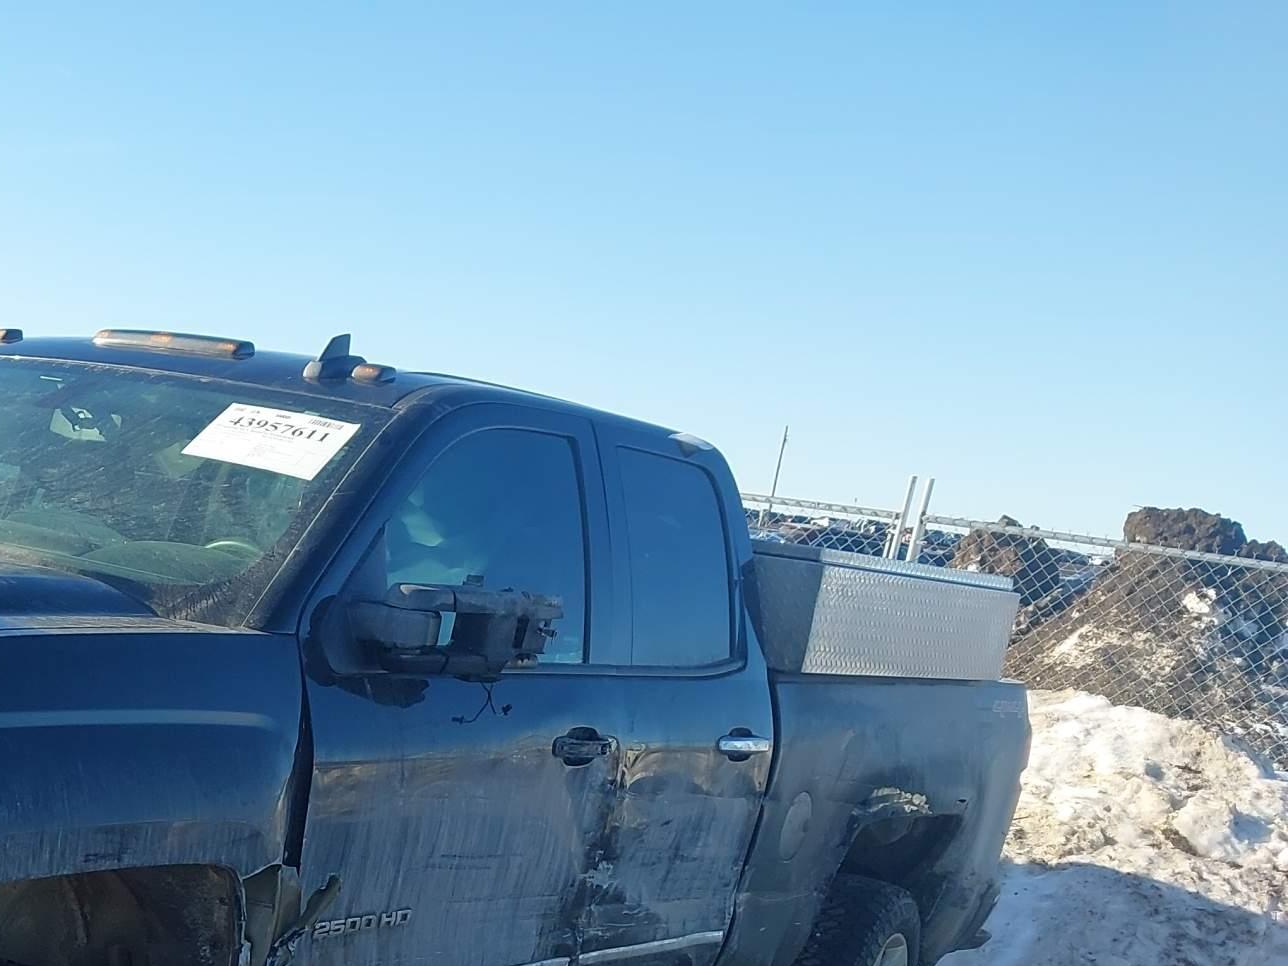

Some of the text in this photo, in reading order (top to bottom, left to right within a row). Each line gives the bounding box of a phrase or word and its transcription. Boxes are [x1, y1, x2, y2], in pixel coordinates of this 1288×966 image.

[228, 416, 331, 443] 43957611
[313, 908, 412, 937] 2500 HD
